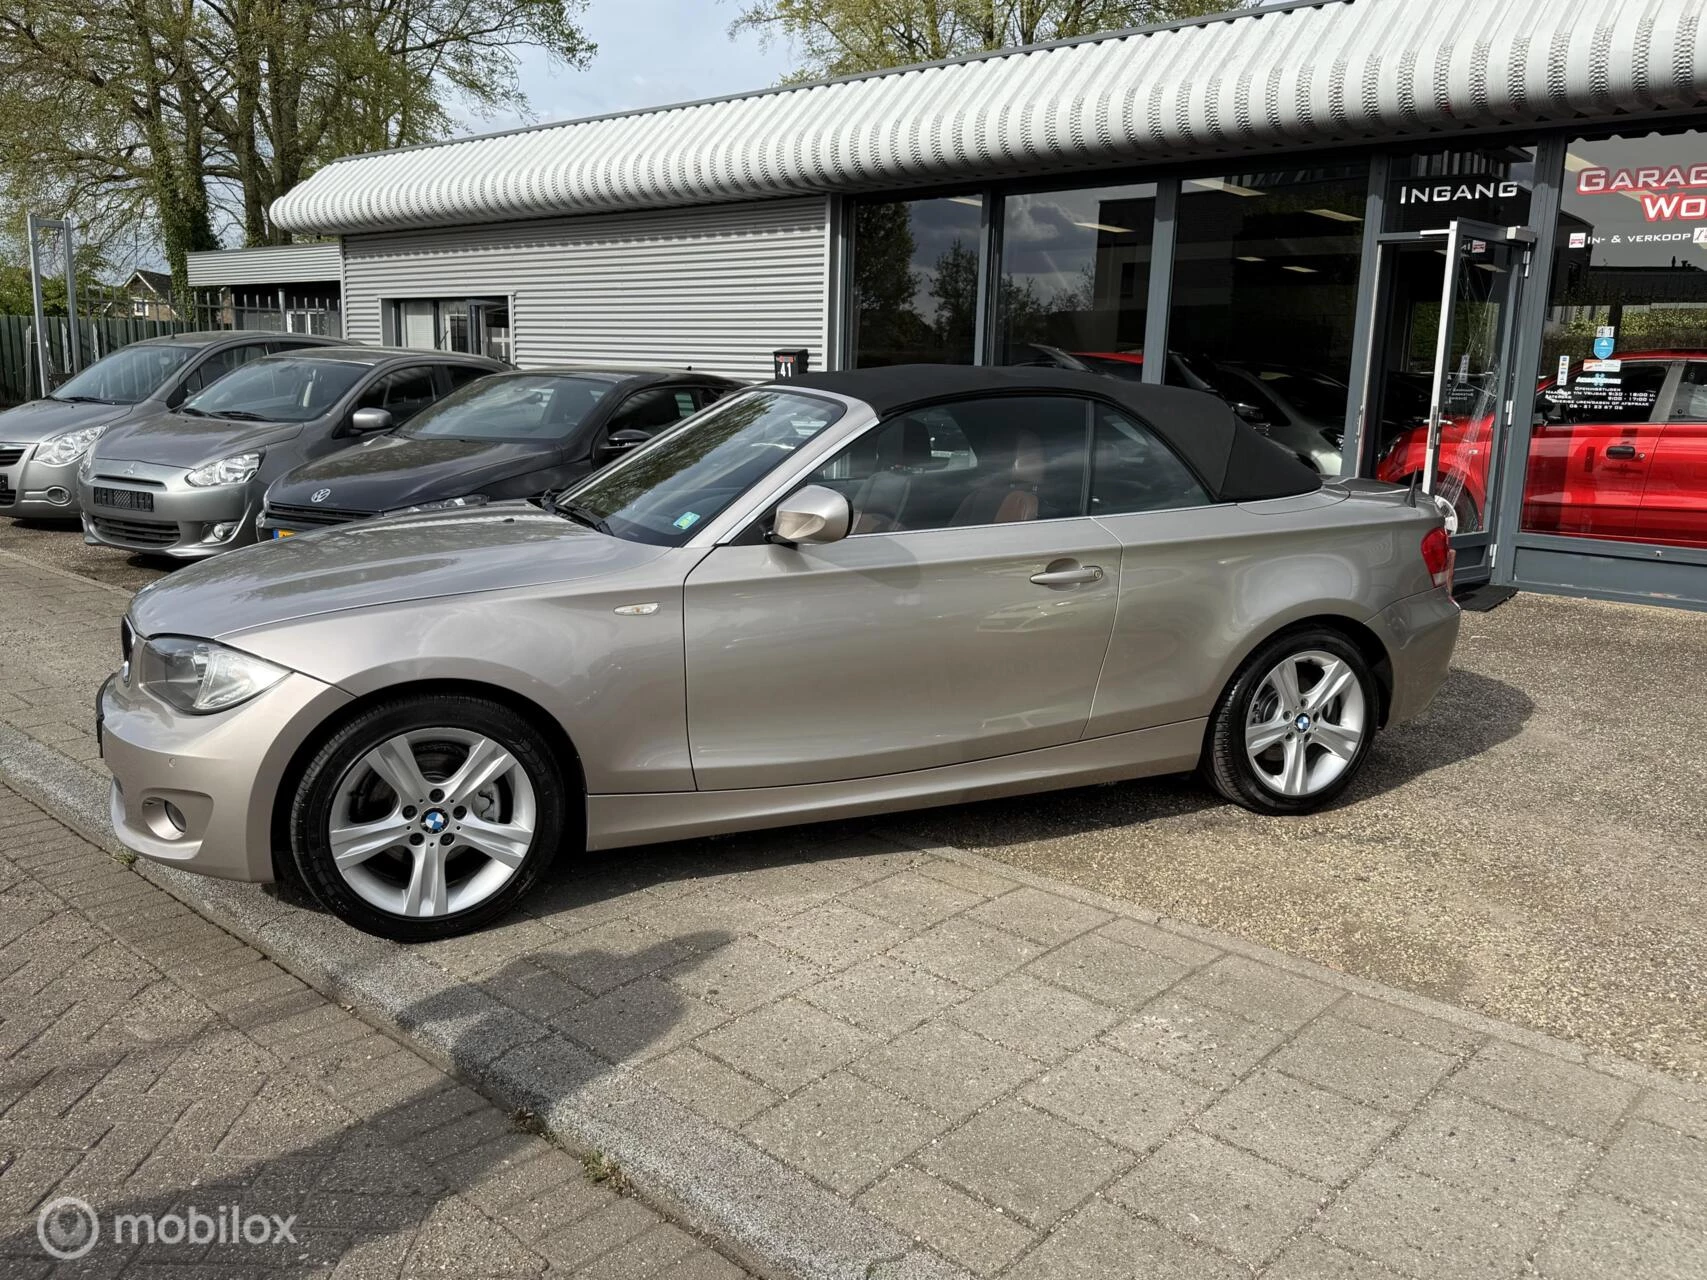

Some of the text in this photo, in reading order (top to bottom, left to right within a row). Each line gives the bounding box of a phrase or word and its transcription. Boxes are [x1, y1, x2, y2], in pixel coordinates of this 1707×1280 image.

[1400, 181, 1518, 204] INGANG
[1587, 236, 1605, 244] IN-
[1611, 235, 1621, 243] &
[1628, 233, 1691, 243] VERKOOP
[1598, 327, 1612, 336] 41
[780, 362, 792, 377] 41
